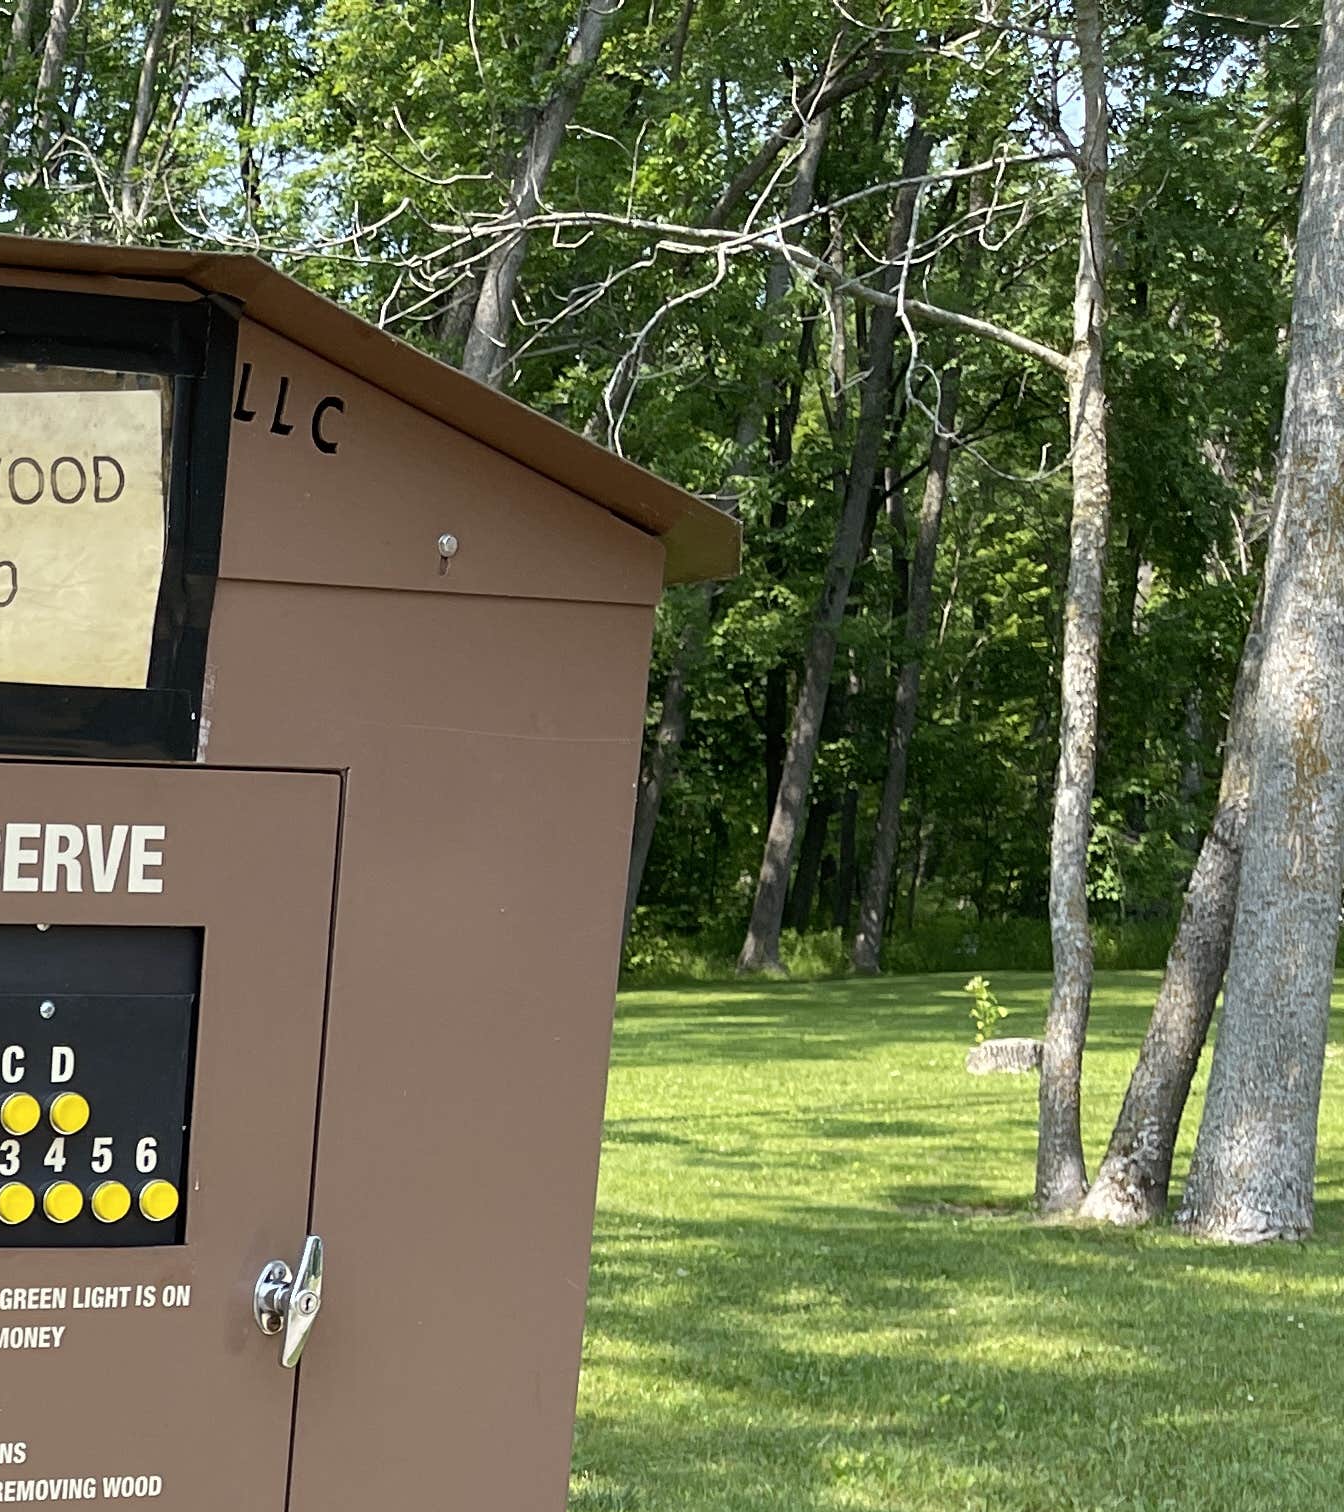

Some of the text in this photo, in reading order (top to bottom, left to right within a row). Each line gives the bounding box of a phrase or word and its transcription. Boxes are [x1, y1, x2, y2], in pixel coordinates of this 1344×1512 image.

[233, 362, 345, 454] LLC
[2, 1046, 24, 1083] C
[51, 1047, 74, 1082] D
[0, 1140, 19, 1175] 3
[44, 1138, 66, 1172] 4
[92, 1137, 112, 1172] 5
[136, 1137, 156, 1172] 6
[0, 1288, 66, 1309] GREEN
[73, 1287, 131, 1308] LIGHT
[135, 1285, 156, 1307] IS
[163, 1286, 190, 1306] ON
[103, 1476, 161, 1497] WOOD
